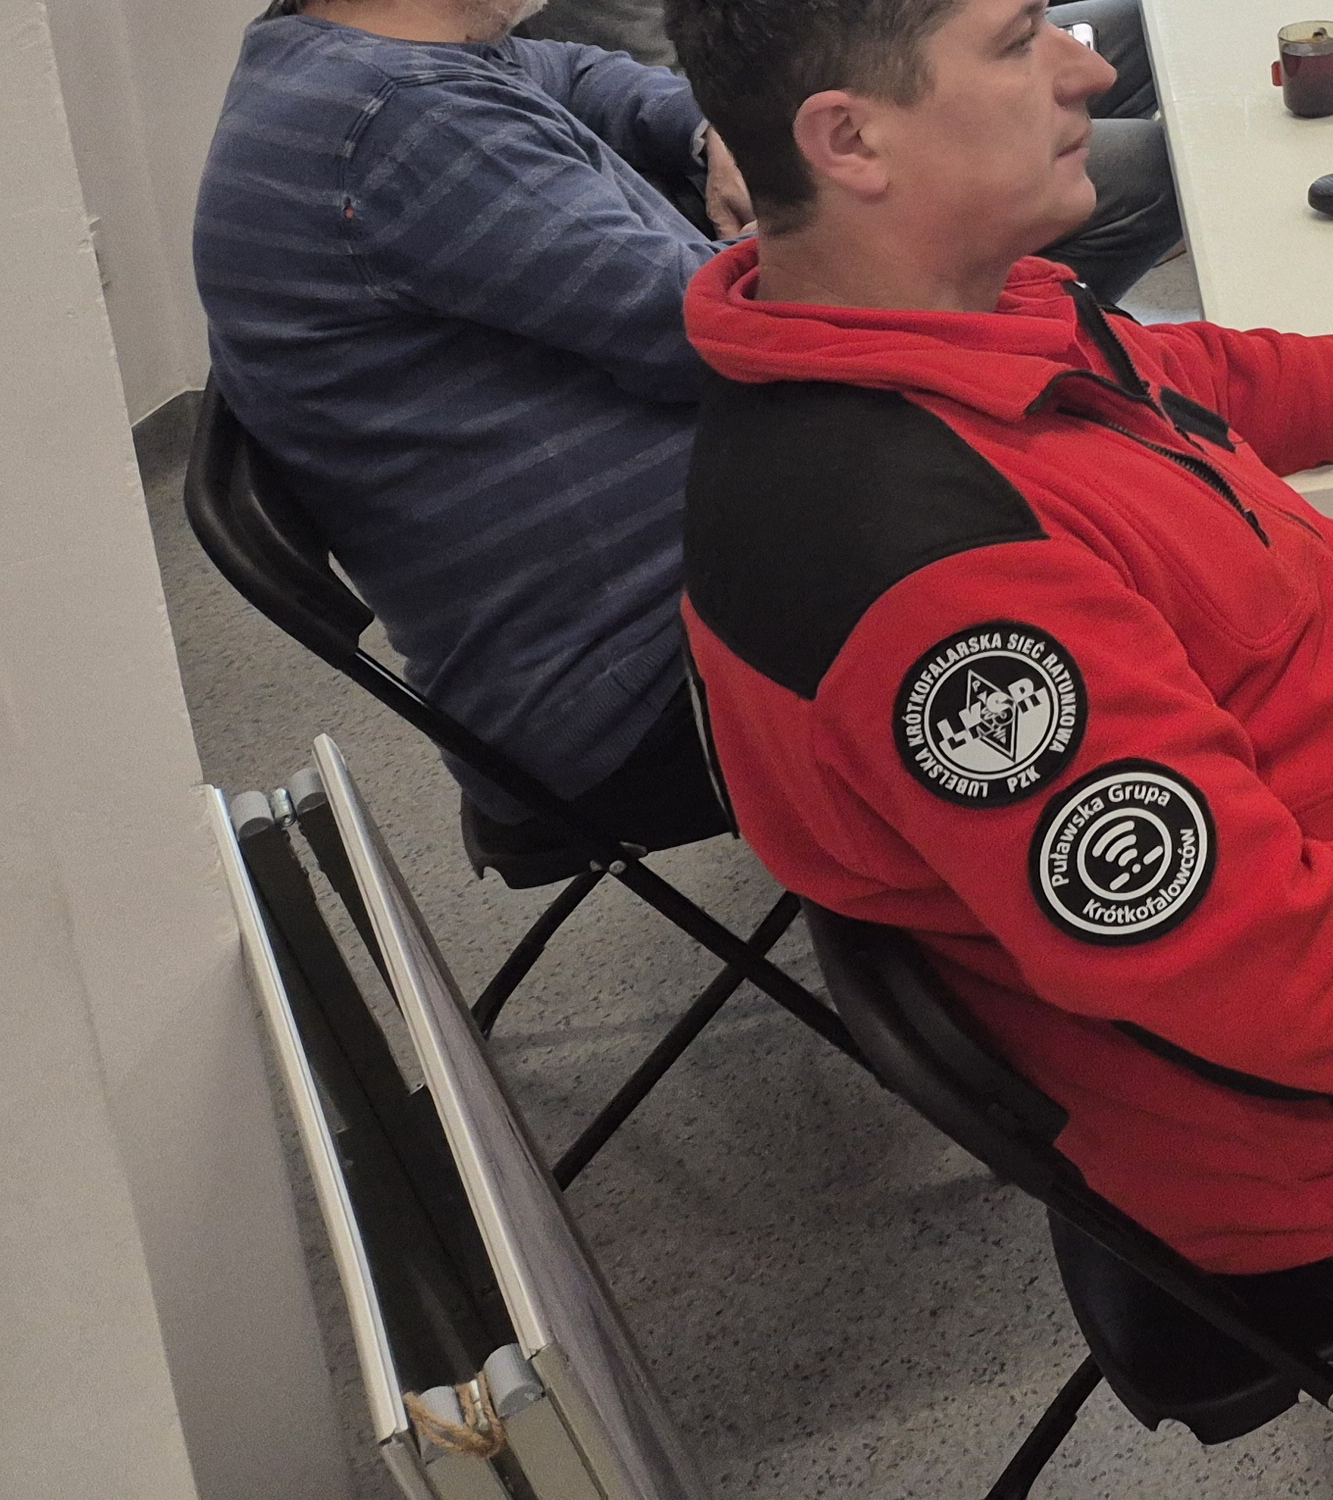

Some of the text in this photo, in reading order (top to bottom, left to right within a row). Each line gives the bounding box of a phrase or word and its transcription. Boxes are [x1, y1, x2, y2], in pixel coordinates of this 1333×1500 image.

[902, 633, 1077, 798] LUBELSKA KRÓTKOFALARSKA SIEĆ RATUNKOWA
[1006, 765, 1041, 793] PZK
[1050, 784, 1171, 887] Puławska Grupa
[1082, 828, 1196, 924] Krótkofalowców
